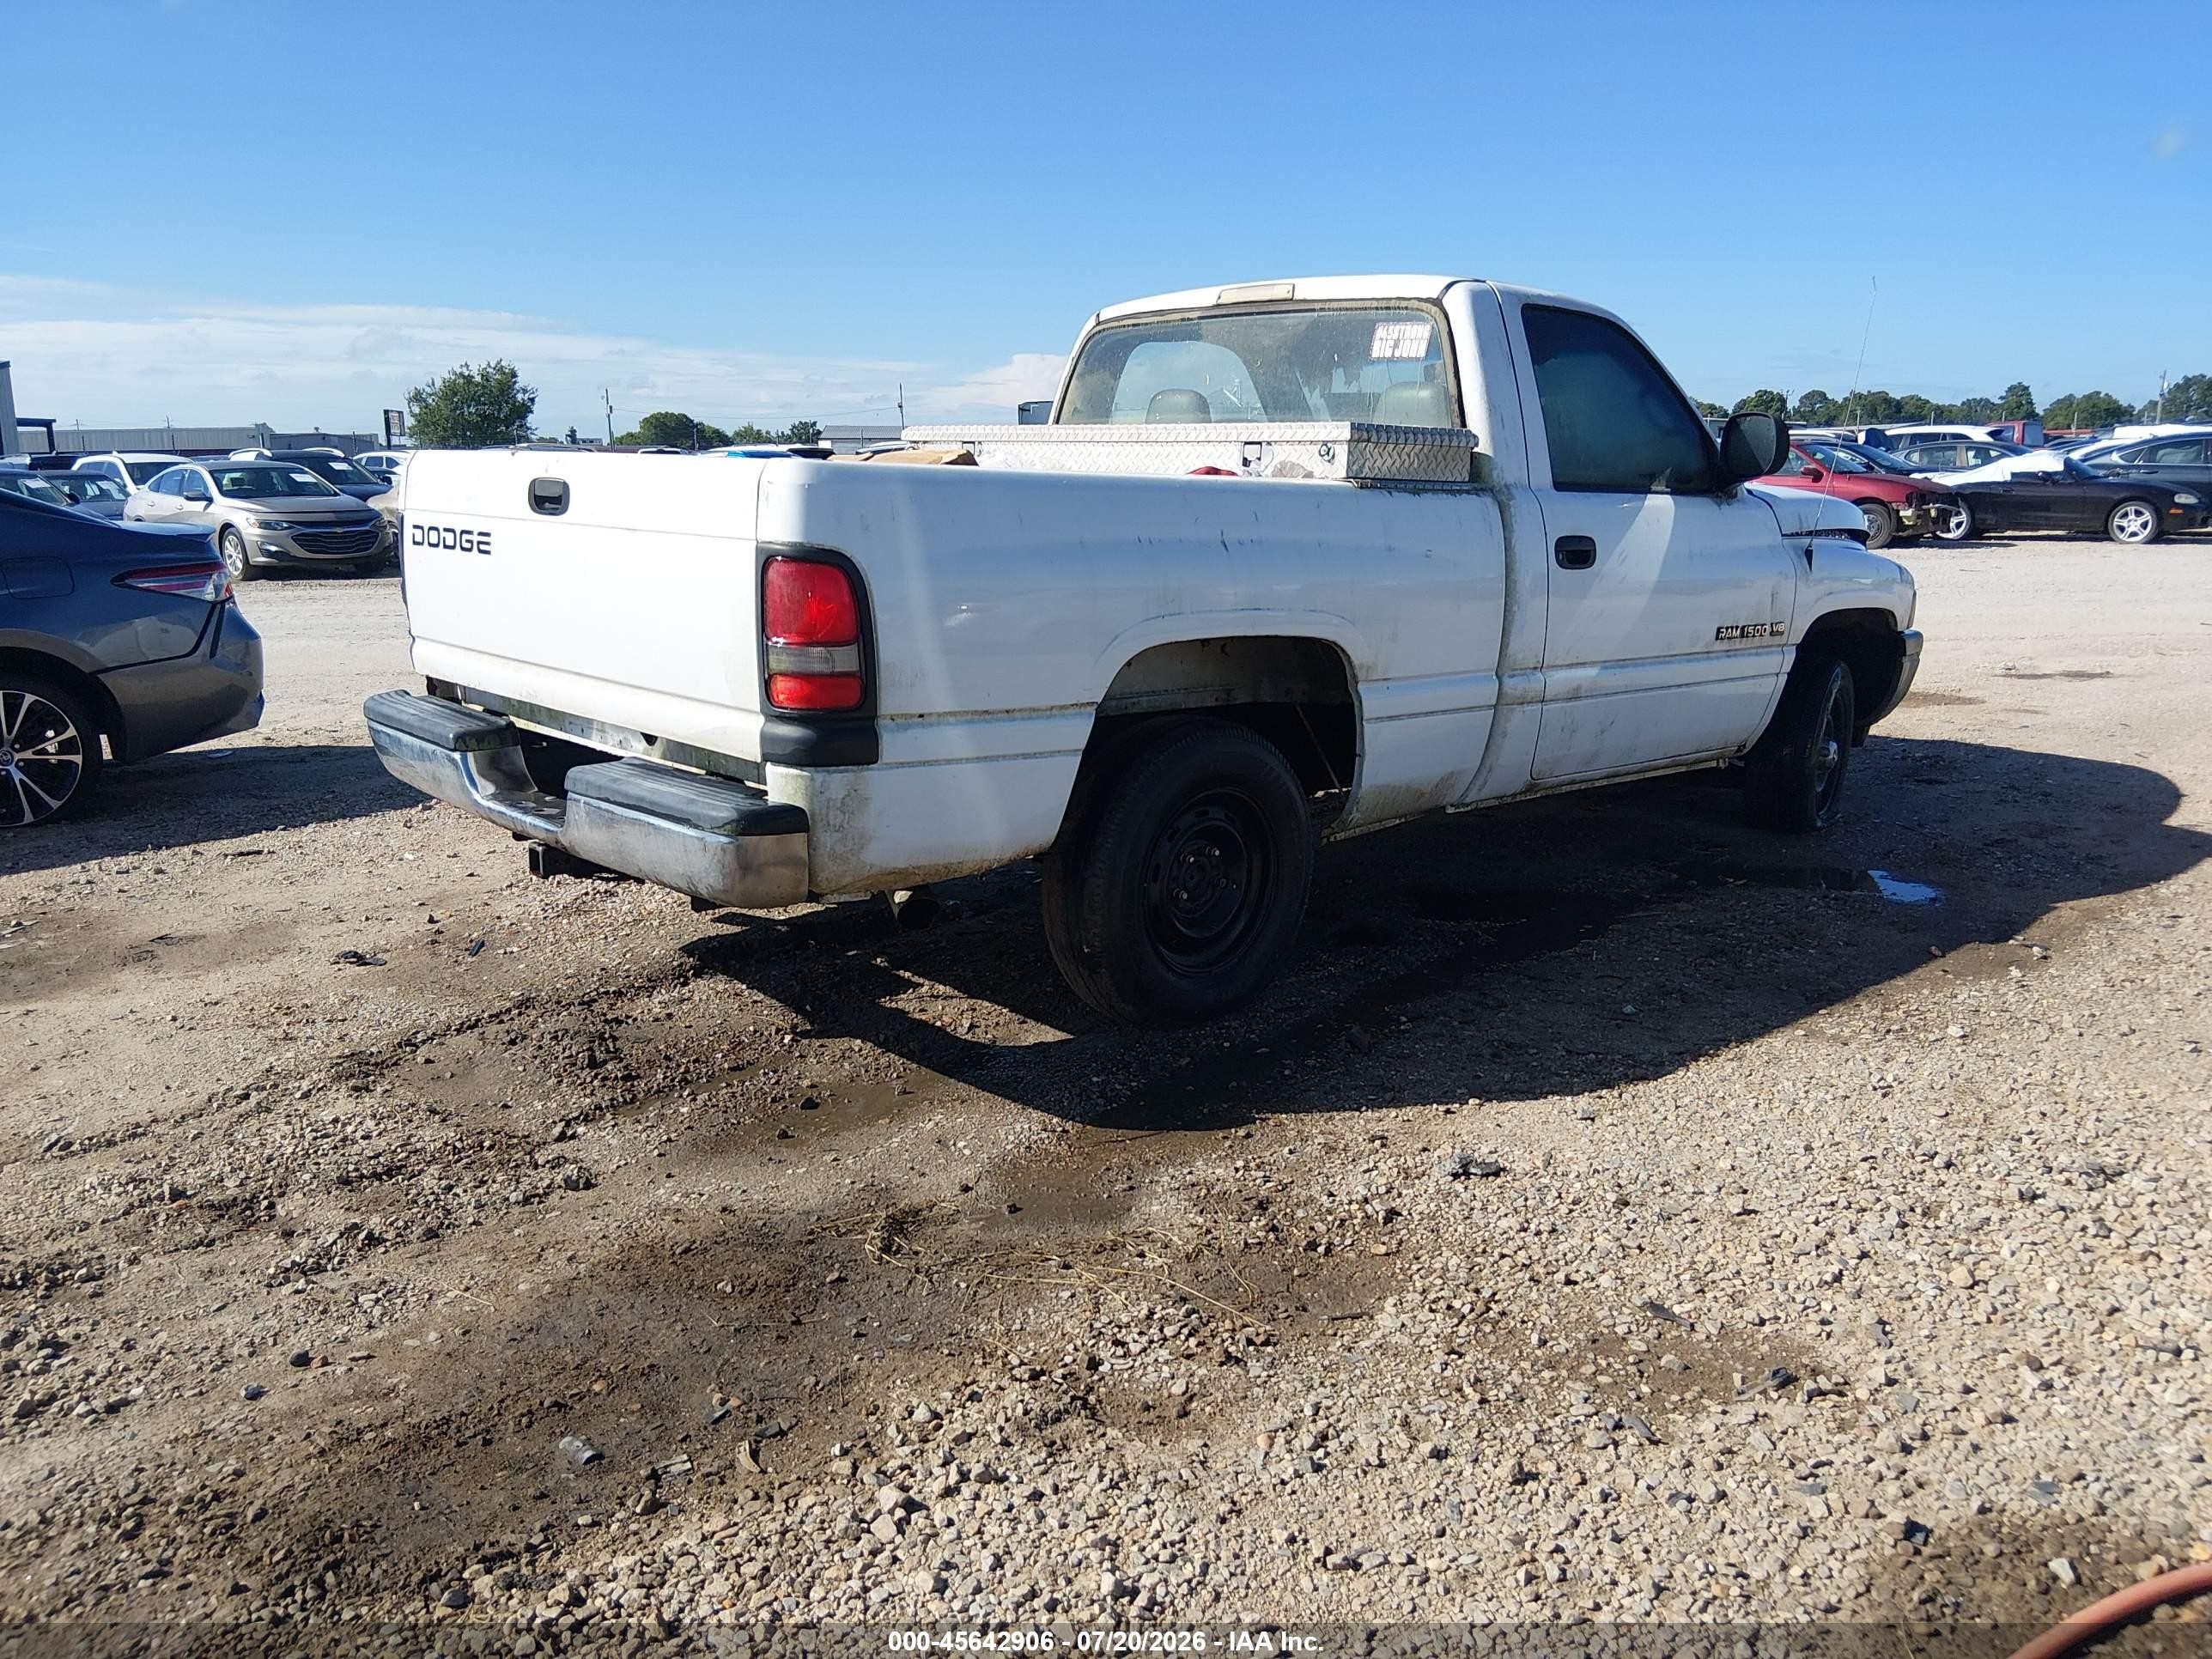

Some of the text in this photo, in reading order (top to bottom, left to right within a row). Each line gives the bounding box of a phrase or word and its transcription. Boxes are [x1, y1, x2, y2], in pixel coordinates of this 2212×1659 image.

[1371, 339, 1429, 358] BIG JOHN
[412, 524, 492, 556] DODGE
[1718, 623, 1785, 640] RAM 1500 V8
